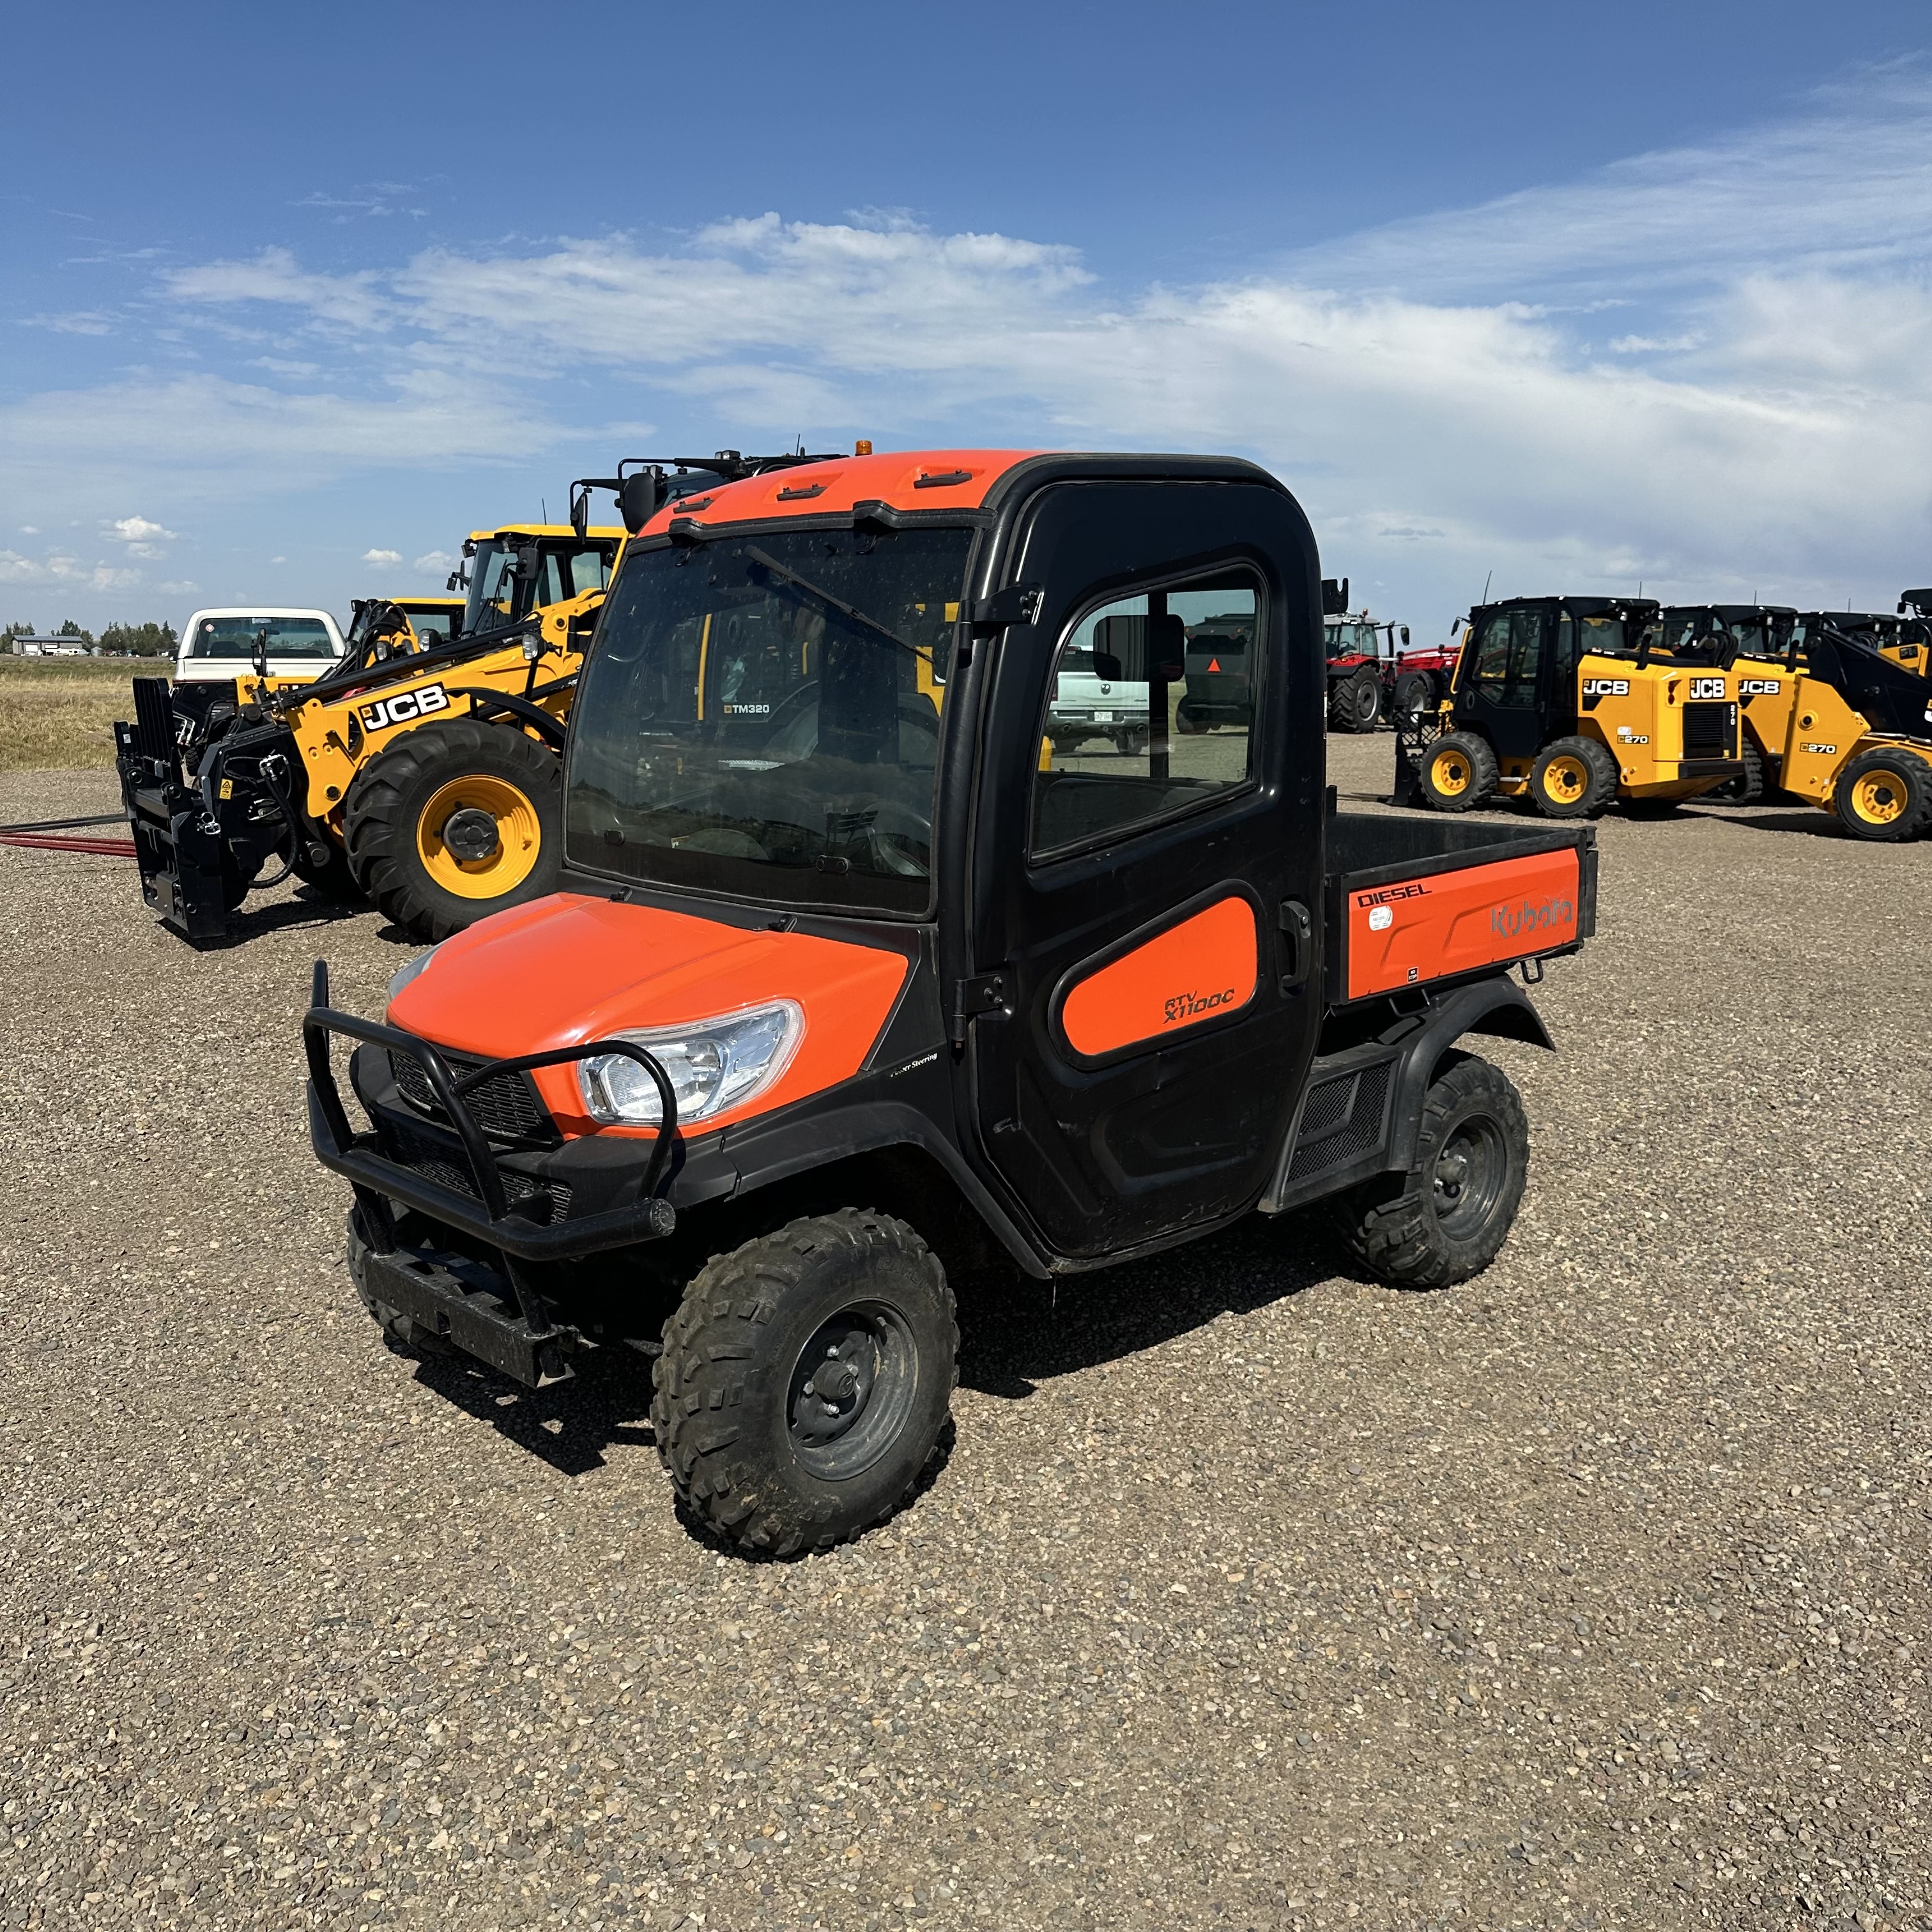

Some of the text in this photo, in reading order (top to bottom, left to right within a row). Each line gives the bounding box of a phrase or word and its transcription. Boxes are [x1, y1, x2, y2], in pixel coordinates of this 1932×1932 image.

[1583, 680, 1629, 694] JCB
[1690, 679, 1724, 698] JCB
[1738, 680, 1779, 694] JCB
[365, 686, 447, 730] JCB
[732, 705, 769, 714] TM320
[1808, 744, 1836, 754] 270
[1357, 884, 1432, 908] DIESEL
[1491, 899, 1572, 939] Kubota
[1162, 988, 1234, 1024] X1100C
[1164, 990, 1197, 1011] RTV
[911, 1053, 937, 1068] Steering
